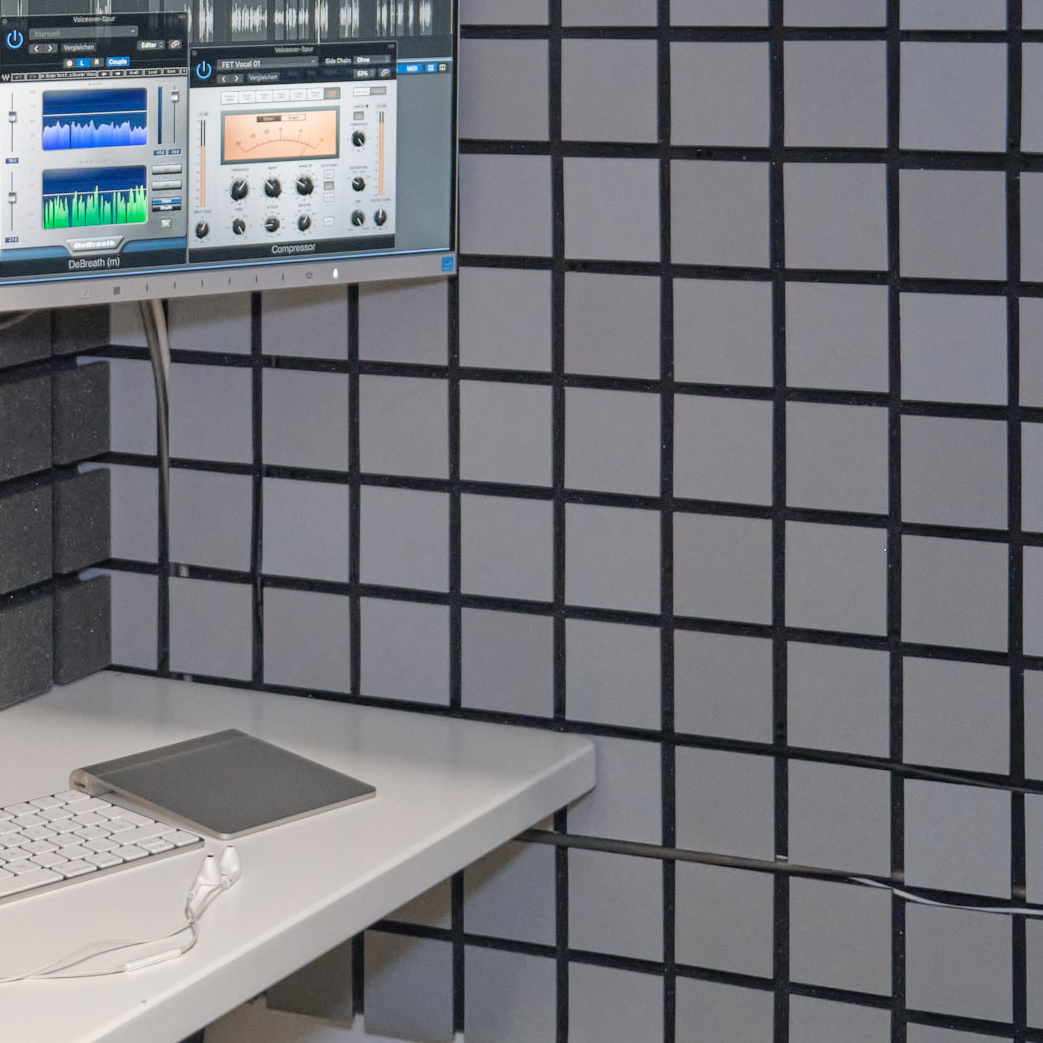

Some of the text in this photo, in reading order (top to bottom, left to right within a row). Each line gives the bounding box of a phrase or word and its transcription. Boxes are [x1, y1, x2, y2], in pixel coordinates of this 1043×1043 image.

[73, 16, 116, 24] Voiceover-Spur
[64, 44, 95, 52] Vergleichen
[275, 46, 314, 54] Voiceover-Spur
[109, 58, 128, 66] Couple
[235, 60, 251, 68] Vocal
[271, 243, 316, 255] Compressor
[69, 257, 120, 269] DeBreath (m)
